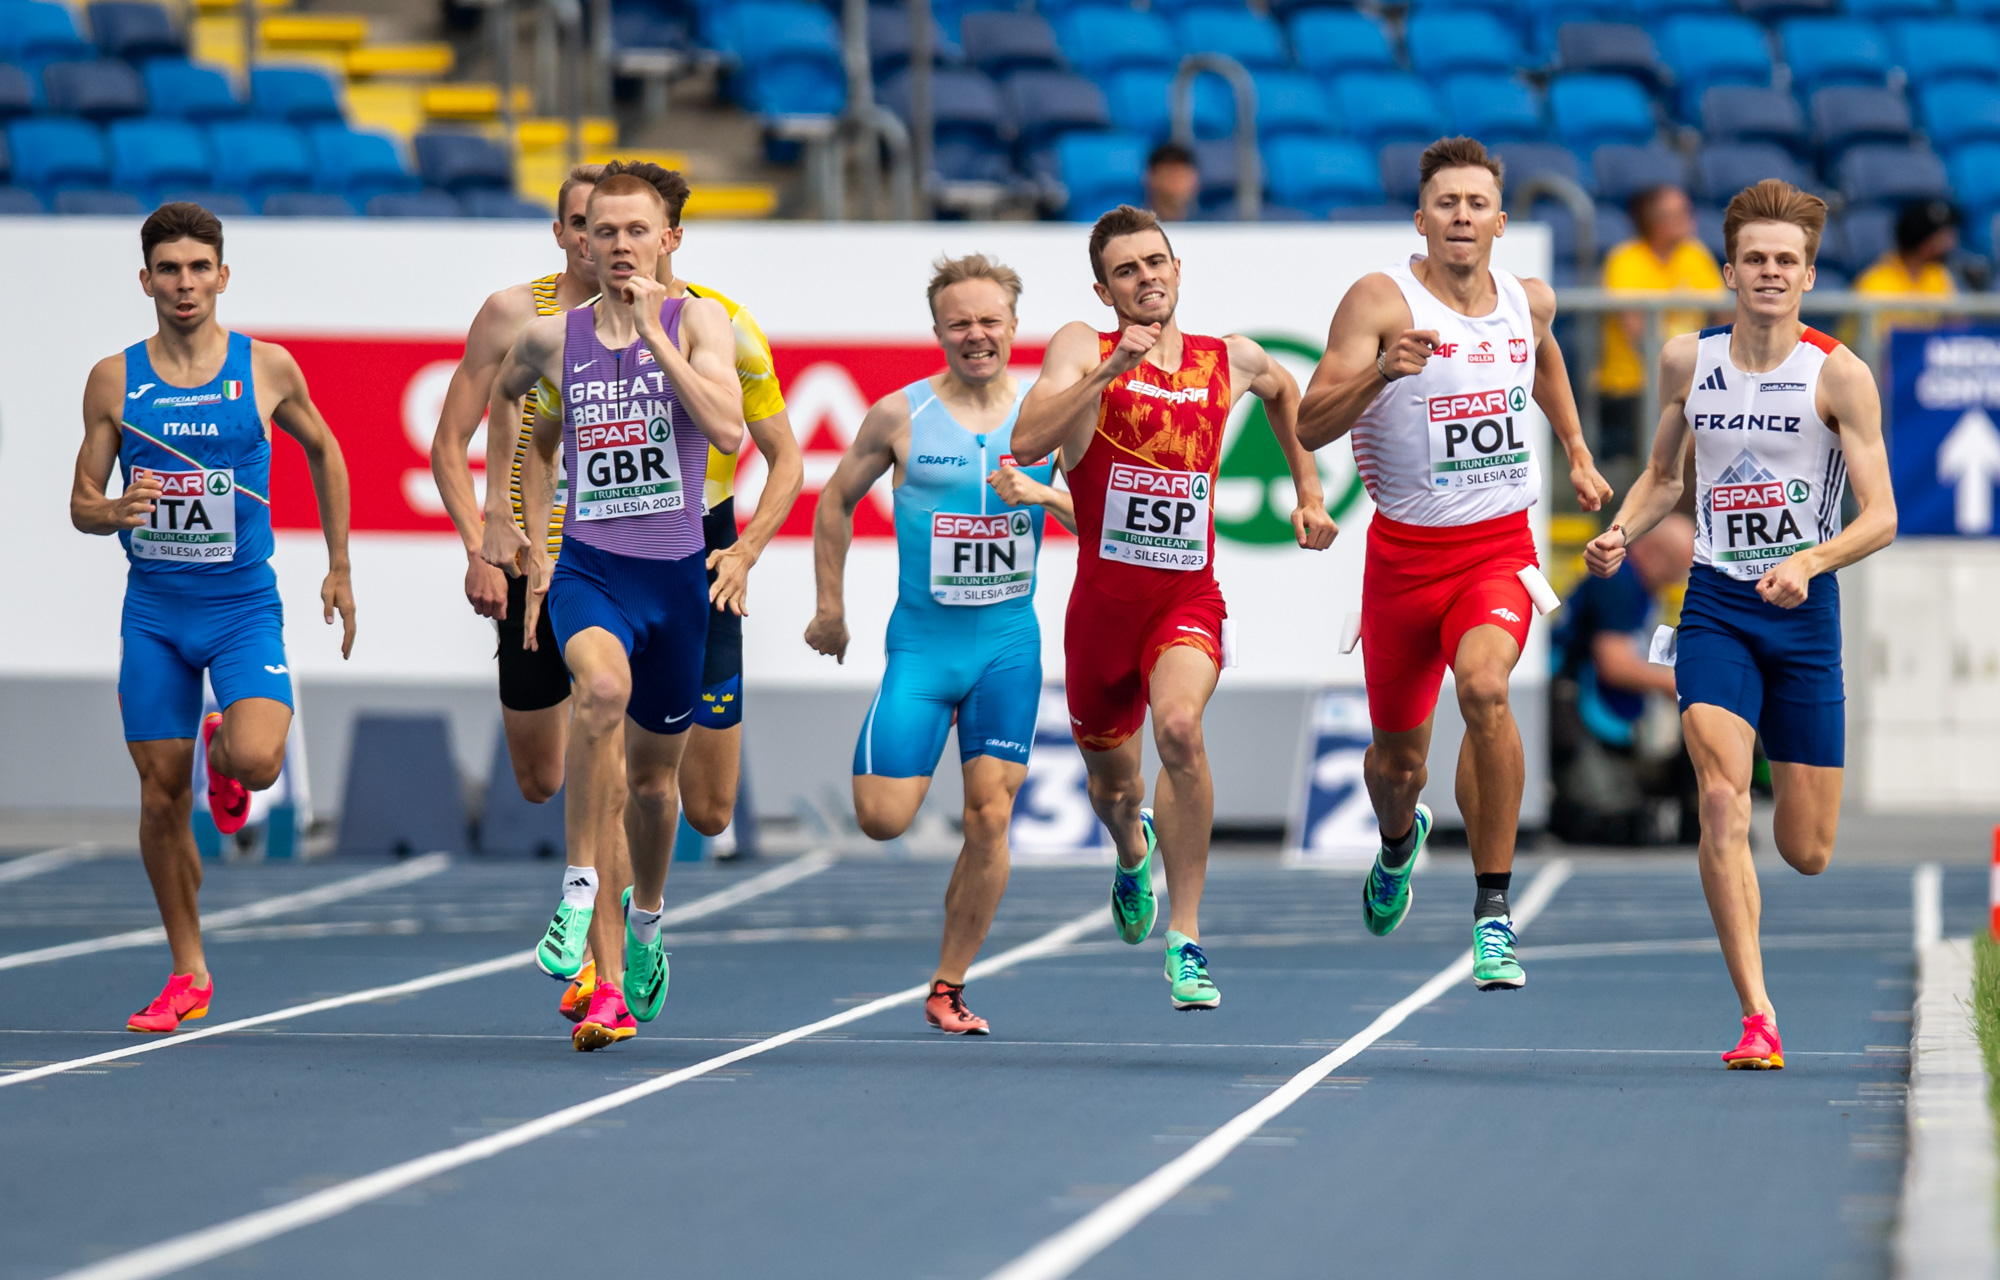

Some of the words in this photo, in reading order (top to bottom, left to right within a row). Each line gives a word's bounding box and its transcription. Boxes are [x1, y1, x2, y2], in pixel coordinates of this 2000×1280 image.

[569, 372, 665, 403] GREAT
[153, 393, 222, 405] FRECCIAROSSA
[1431, 394, 1506, 419] SPAR
[572, 400, 673, 424] BRITAIN
[163, 422, 219, 436] ITALIA
[1694, 414, 1801, 433] FRANCE
[579, 423, 645, 448] SPAR
[1444, 416, 1524, 458] POL
[586, 447, 672, 487] GBR
[917, 454, 957, 465] CRAFT
[1460, 460, 1482, 470] RUN
[1113, 470, 1189, 496] SPAR
[1467, 470, 1507, 485] SILESIA
[1509, 465, 1528, 479] 202
[598, 489, 620, 499] RUN
[1714, 485, 1784, 509] SPAR
[150, 499, 213, 531] ITA
[606, 501, 650, 515] SILESIA
[652, 496, 681, 510] 2023
[1125, 496, 1196, 536] ESP
[153, 533, 175, 541] RUN
[936, 517, 1008, 537] SPAR
[1727, 509, 1803, 548] FRA
[1130, 534, 1153, 545] RUN
[160, 545, 202, 557] SILESIA
[204, 546, 233, 557] 2023
[953, 540, 1015, 574] FIN
[1134, 549, 1179, 564] SILESIA
[1738, 550, 1760, 560] RUN
[958, 576, 980, 585] RUN
[964, 588, 1004, 600] SILESIA
[1005, 583, 1029, 596] 2023
[985, 738, 1021, 751] CRAFT
[1012, 750, 1094, 849] 3
[1311, 751, 1380, 850] 2
